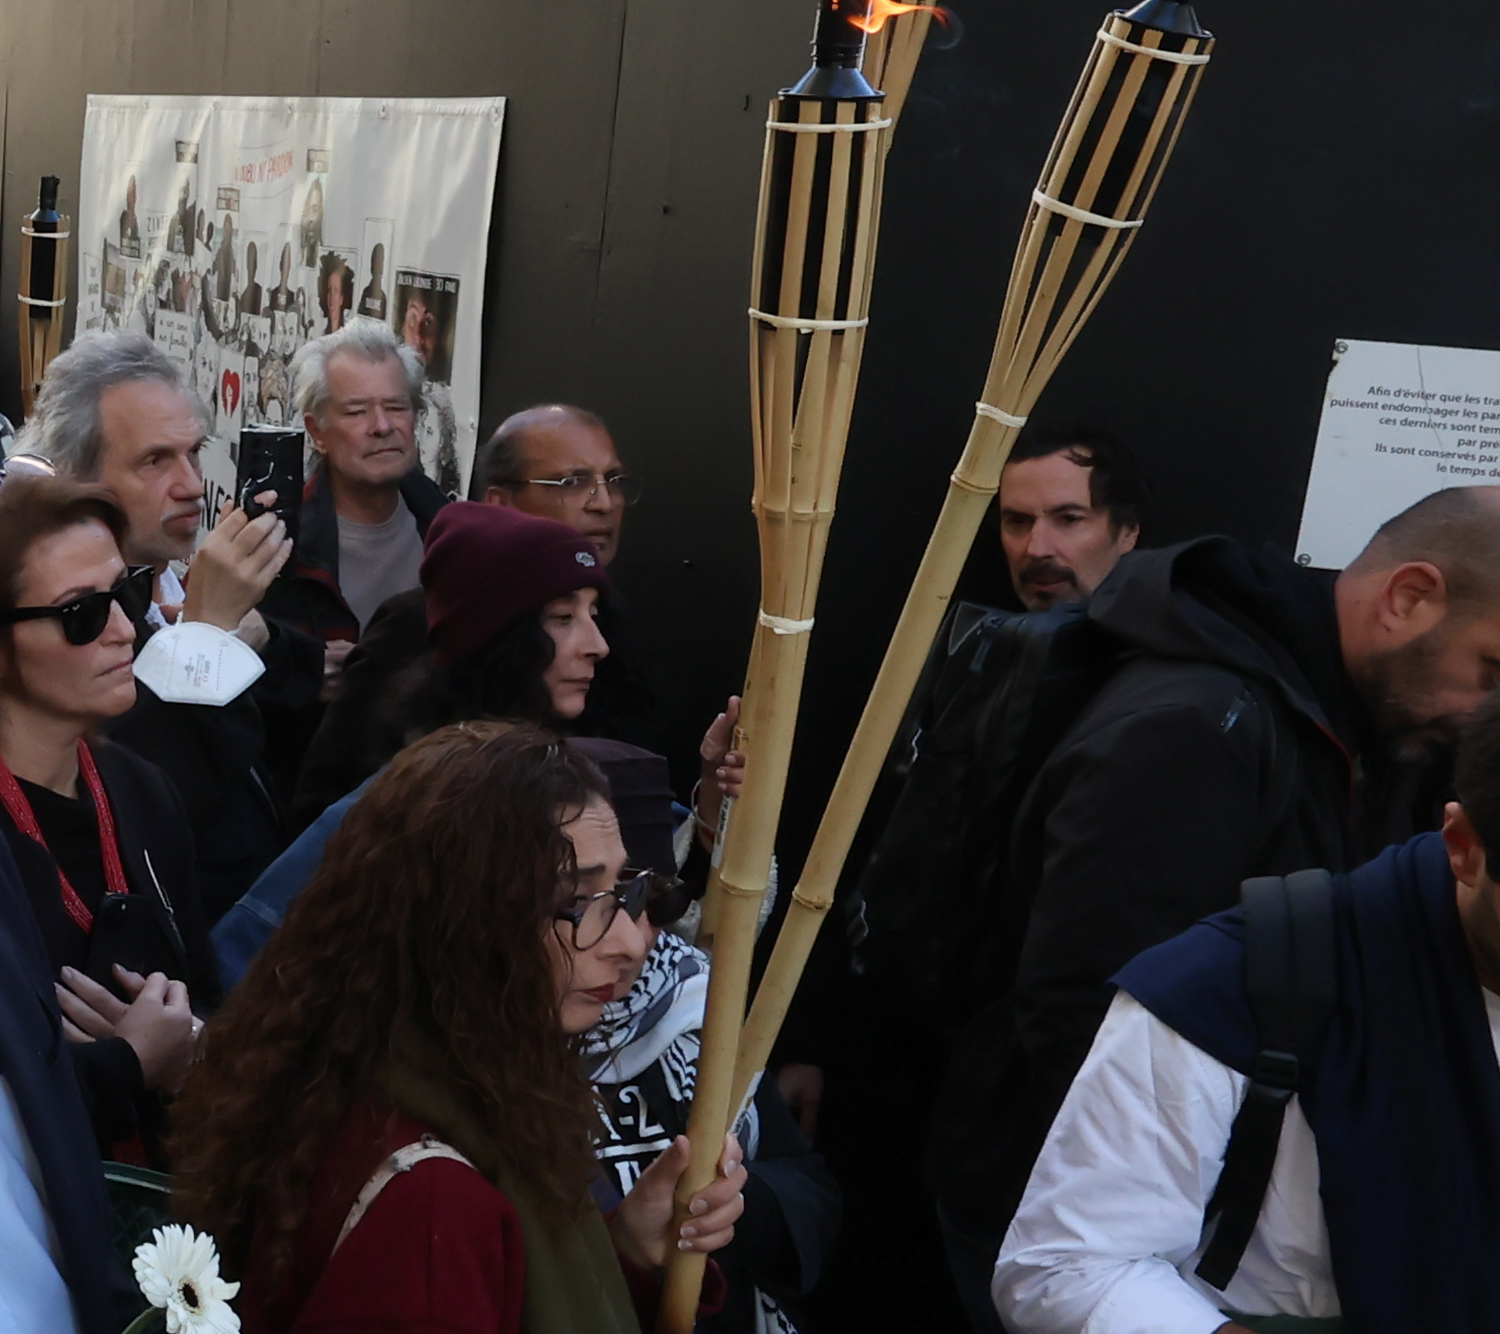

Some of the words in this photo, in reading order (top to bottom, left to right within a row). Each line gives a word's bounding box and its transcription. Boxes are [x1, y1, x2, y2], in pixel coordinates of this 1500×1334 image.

[1367, 386, 1390, 396] Afin
[1439, 393, 1462, 405] que
[1464, 394, 1481, 405] les
[1330, 398, 1379, 410] puissent
[1463, 408, 1478, 419] les
[1379, 417, 1397, 426] ces
[1450, 422, 1476, 433] sont
[1457, 438, 1477, 448] par
[1375, 443, 1387, 453] Ils
[1390, 447, 1415, 456] sont
[1418, 448, 1476, 461] conservés
[1478, 454, 1498, 464] par
[1436, 463, 1448, 473] le
[1450, 465, 1486, 478] temps
